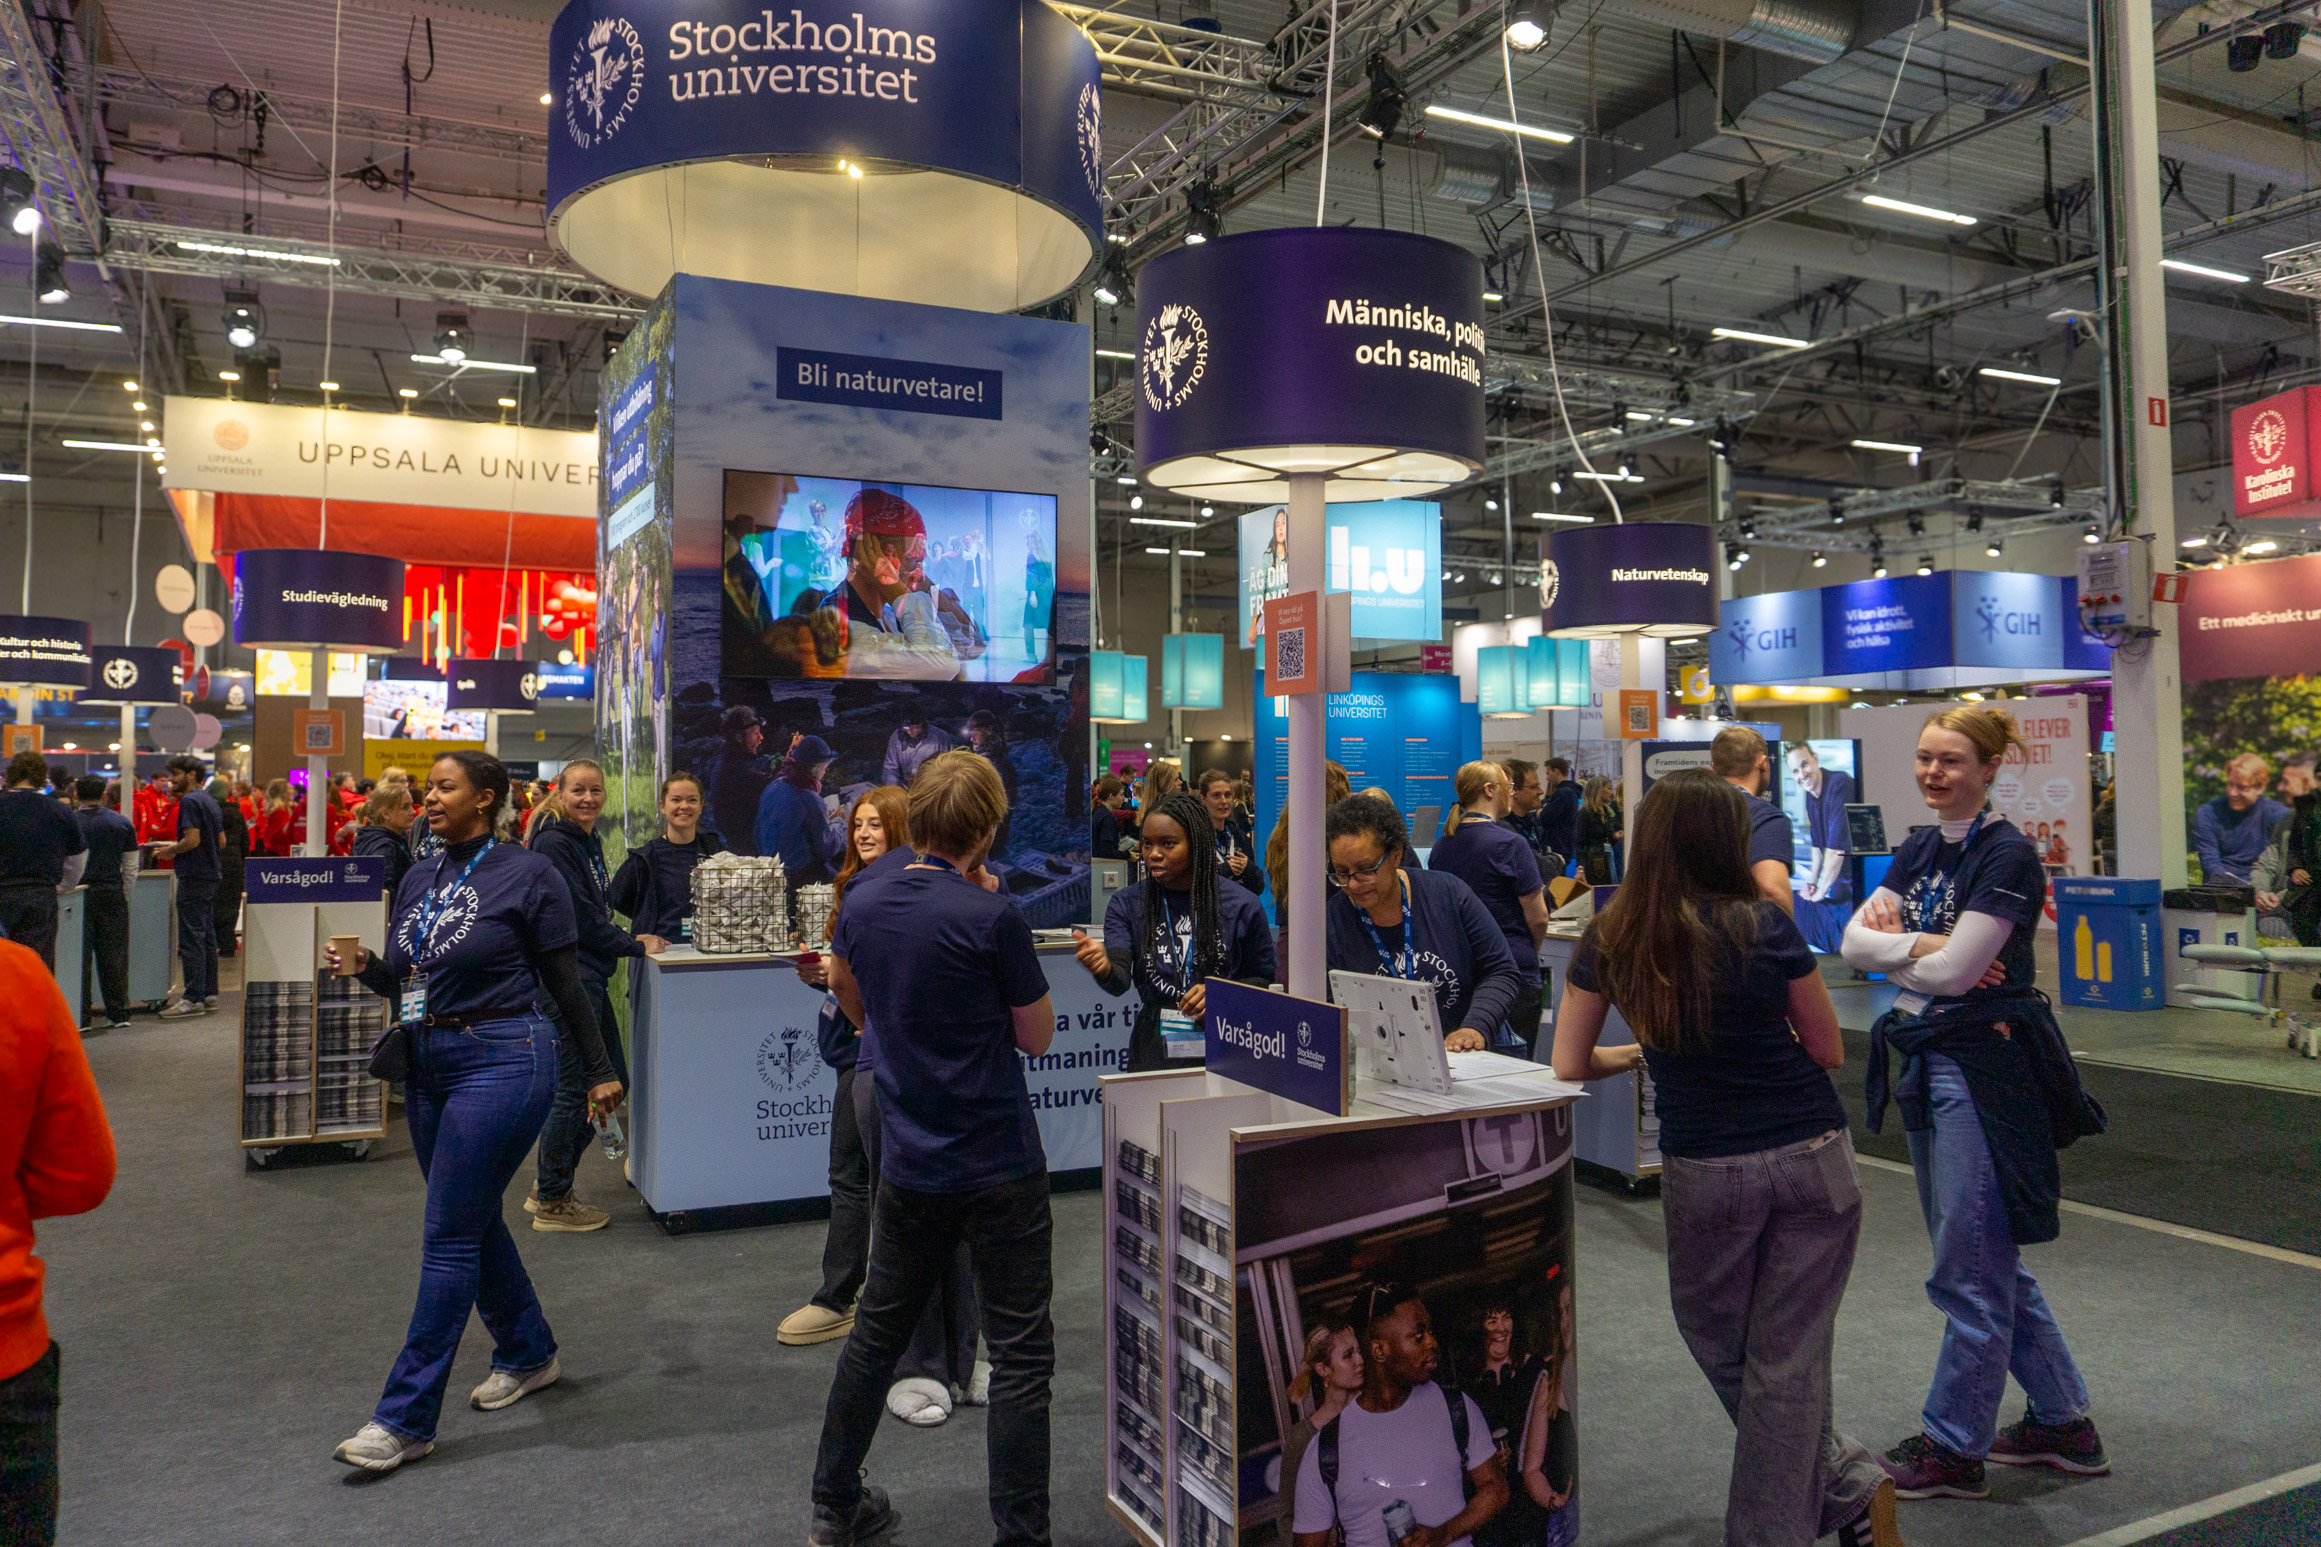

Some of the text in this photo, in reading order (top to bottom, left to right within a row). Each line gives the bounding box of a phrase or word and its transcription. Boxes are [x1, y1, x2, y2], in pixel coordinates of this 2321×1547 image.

[669, 9, 937, 64] Stockholms
[605, 17, 645, 140] STOCKHOLMS
[668, 54, 918, 103] universitet
[566, 37, 590, 149] UNIVERSITET
[1325, 299, 1451, 342] Människa,
[1174, 305, 1208, 407] STOCKHOLMS
[1355, 339, 1481, 387] och samhälle
[797, 362, 984, 403] Bli naturvetare!
[299, 441, 463, 475] UPPSALA
[2244, 464, 2295, 490] Karolinska
[2248, 480, 2293, 503] Institutet
[1249, 566, 1265, 592] ÄG
[1611, 567, 1709, 586] Naturvetenskap
[282, 590, 388, 612] Studievägledning
[2004, 612, 2041, 635] GIH
[2199, 616, 2221, 630] Ett
[2222, 608, 2304, 628] medicinskt
[31, 638, 50, 648] och
[51, 639, 82, 650] historia
[1757, 627, 1797, 651] GIH
[11, 650, 31, 659] och
[1328, 694, 1384, 706] LINKÖPINGS
[1328, 707, 1388, 718] UNIVERSITET
[1655, 758, 1698, 766] Framtidens
[261, 869, 334, 887] Varsågod!
[434, 886, 479, 958] STOCKHOLMS
[1077, 1003, 1116, 1031] vår
[1216, 1015, 1286, 1060] Varsågod!
[1297, 1047, 1326, 1063] Stockholms
[1297, 1056, 1324, 1071] universitet
[757, 1094, 833, 1120] Stockh
[757, 1118, 831, 1141] univer
